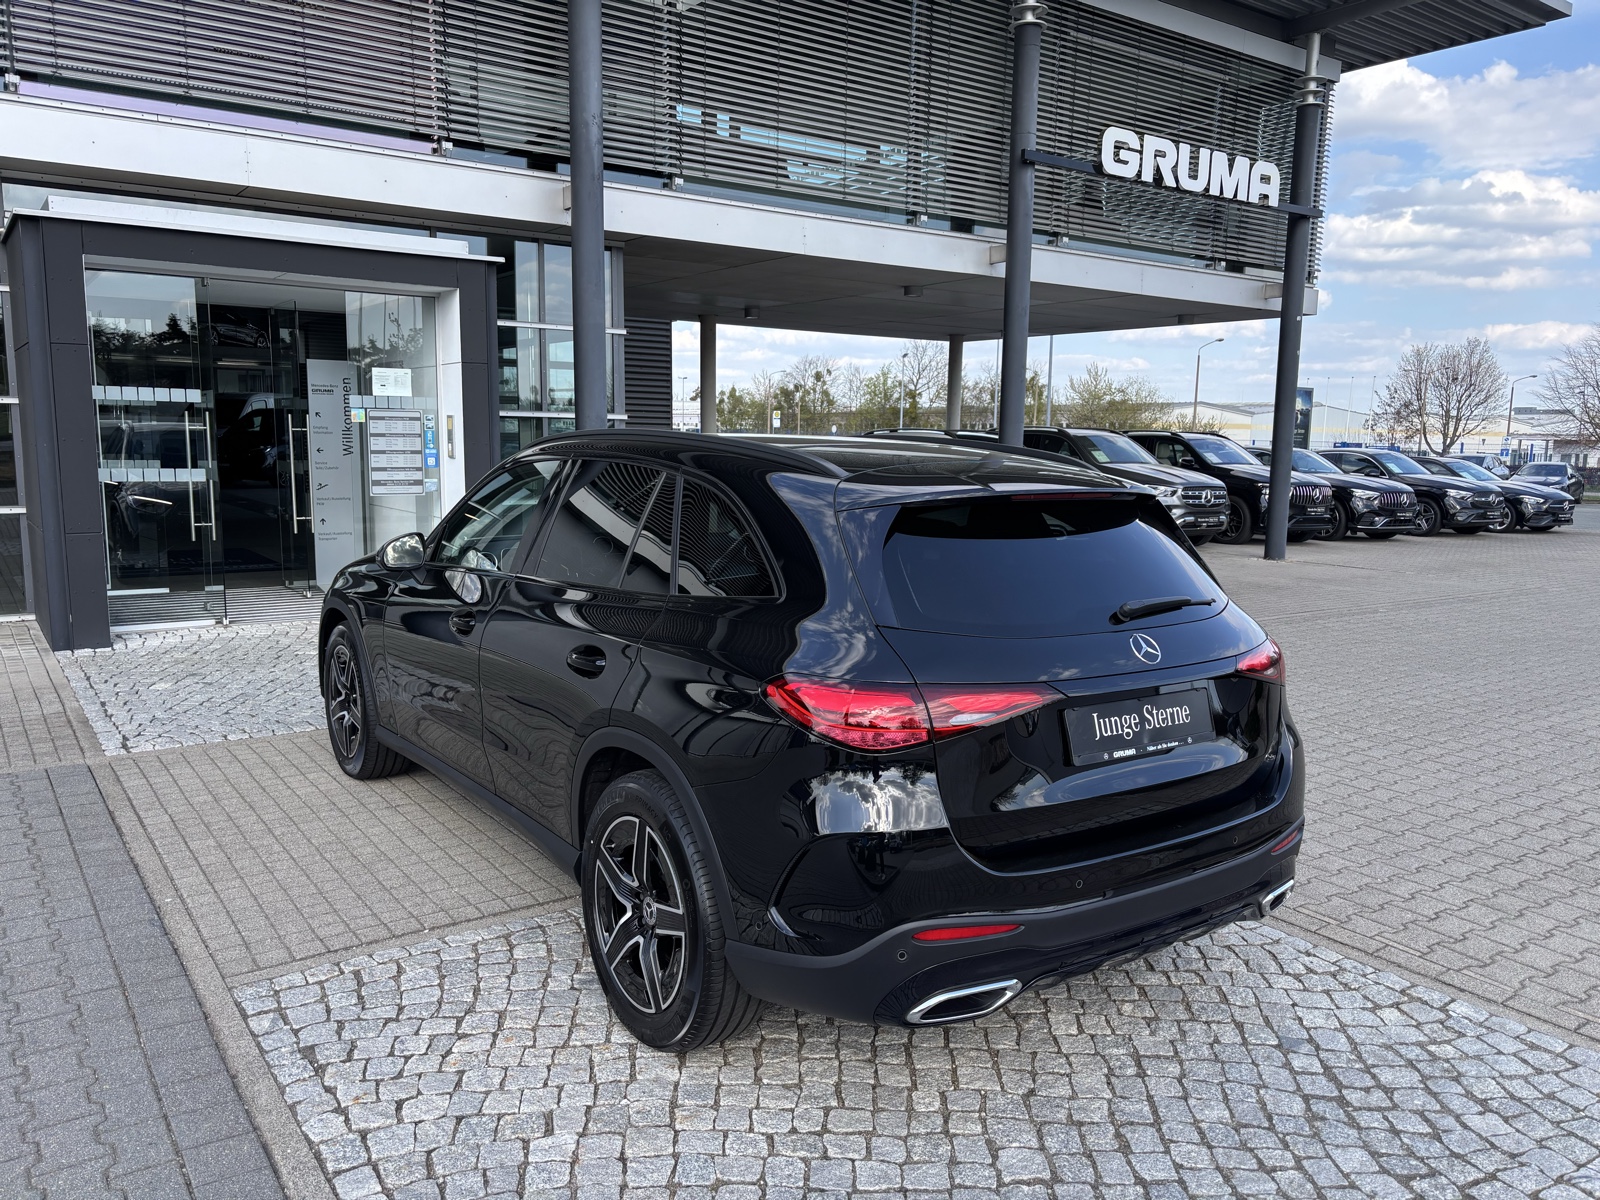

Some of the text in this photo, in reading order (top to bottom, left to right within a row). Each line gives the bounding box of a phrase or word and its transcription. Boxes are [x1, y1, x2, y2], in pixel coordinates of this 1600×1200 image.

[1101, 126, 1281, 207] GRUMA
[342, 377, 354, 457] Willkommen
[1092, 704, 1191, 741] Junge Sterne
[1113, 748, 1136, 758] GRUMA
